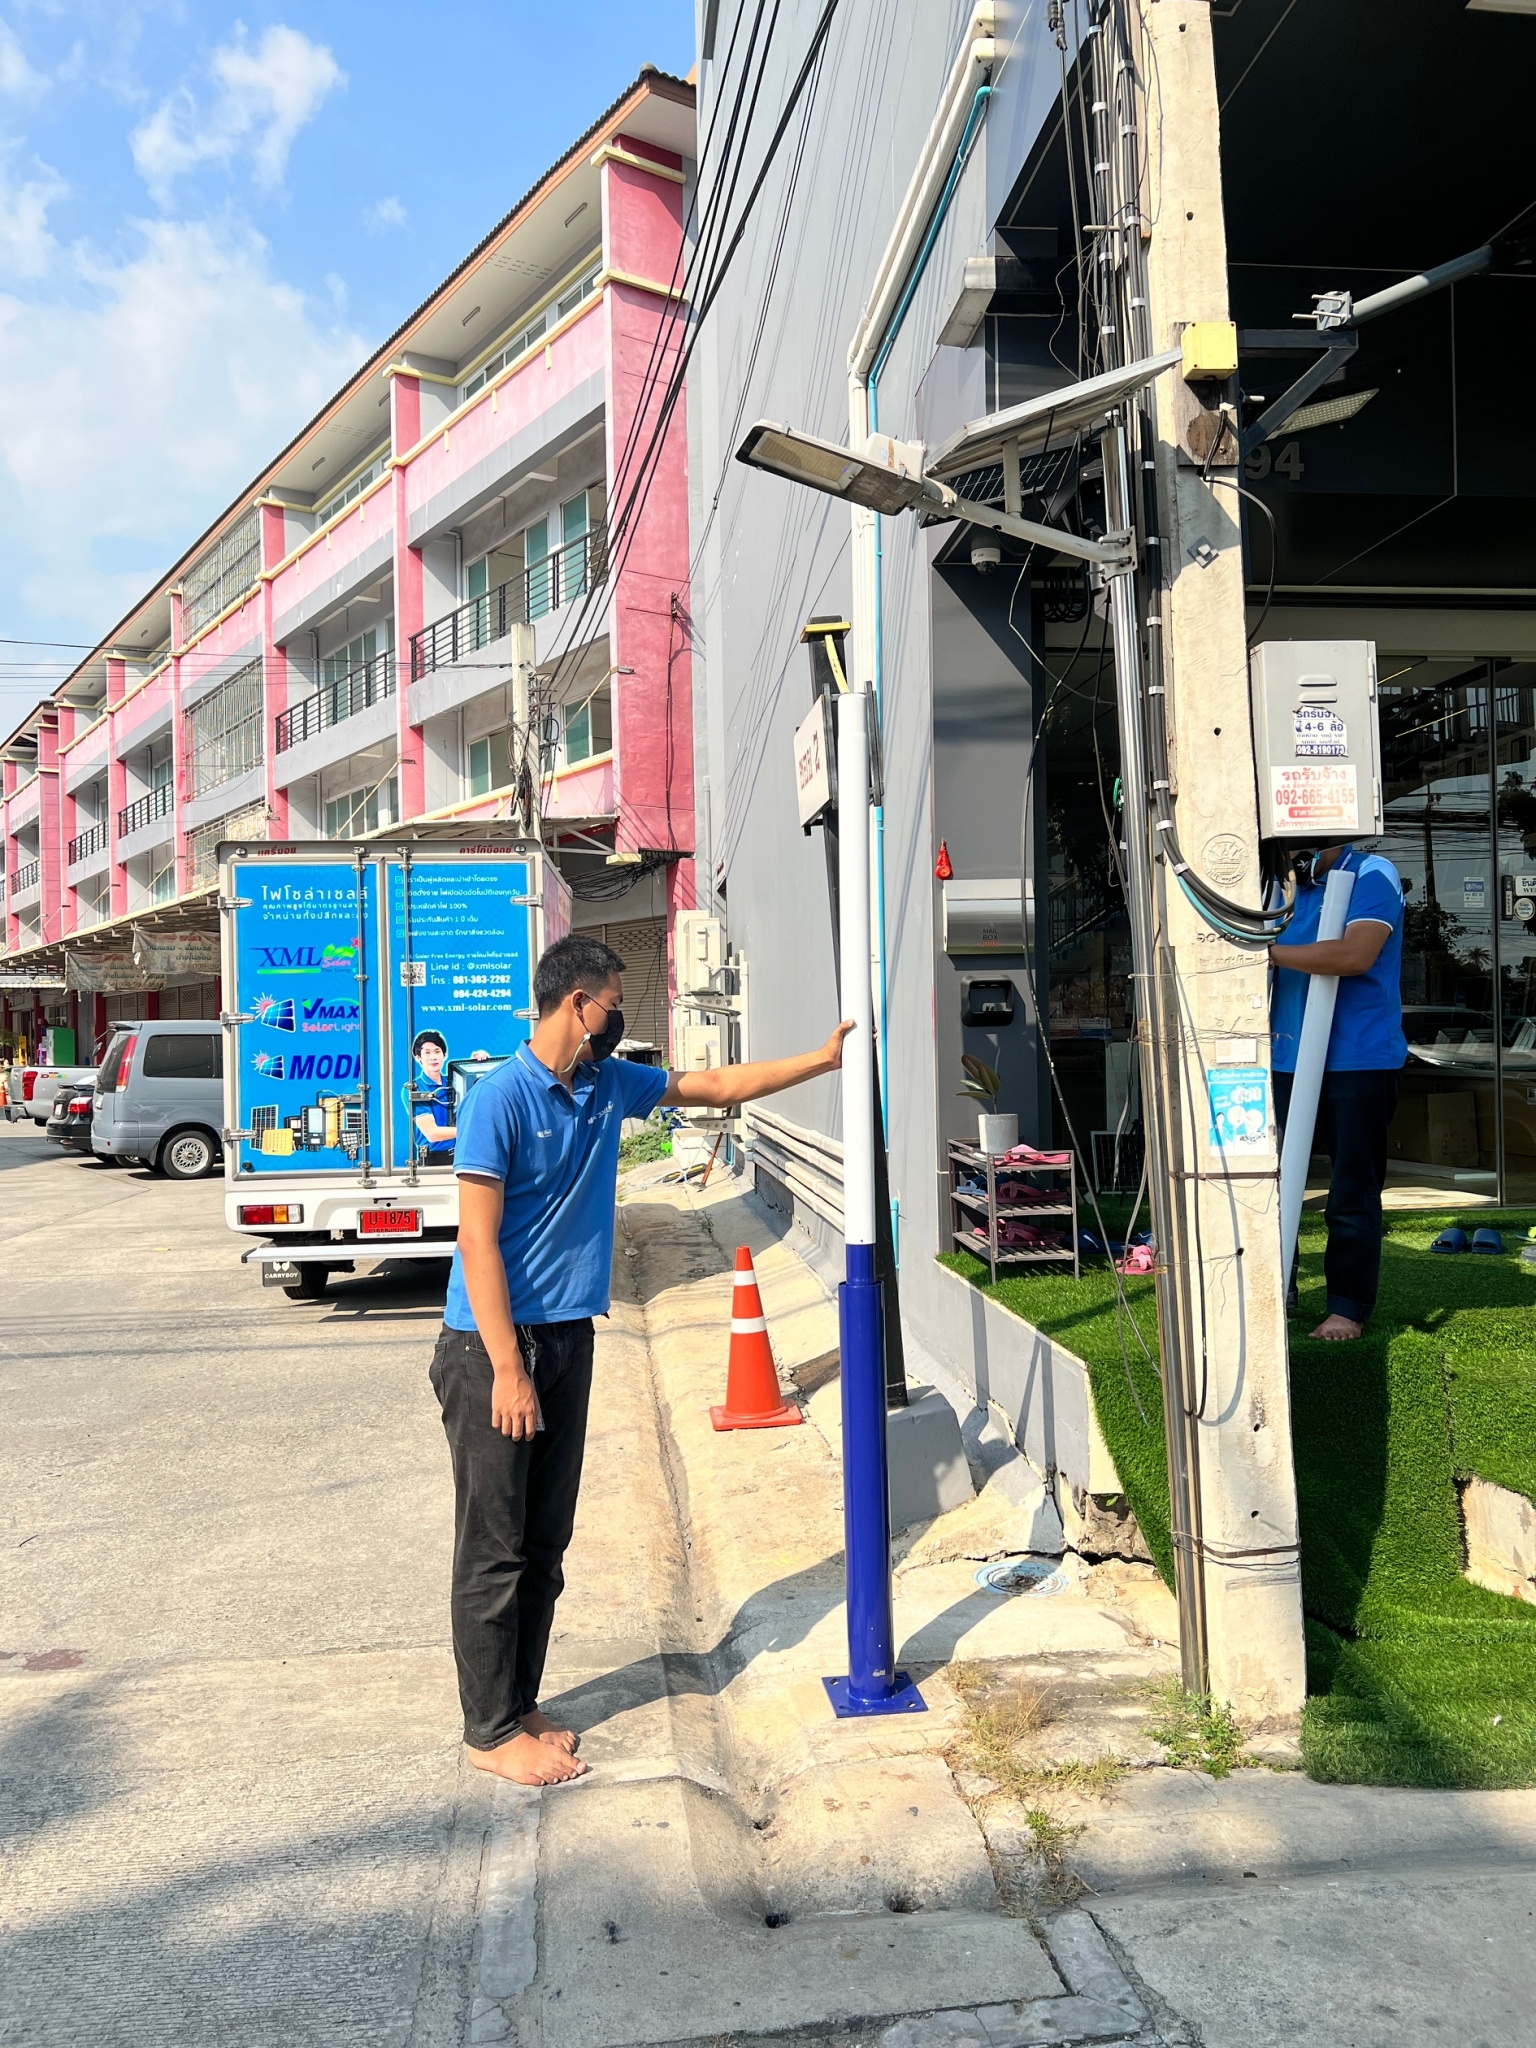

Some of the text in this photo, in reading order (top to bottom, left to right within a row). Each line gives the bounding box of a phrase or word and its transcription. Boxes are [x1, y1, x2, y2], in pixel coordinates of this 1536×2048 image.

[1304, 721, 1344, 732] 4-6 ล้อ
[1282, 766, 1346, 780] รถรับจ้าง
[1276, 789, 1355, 805] 092-665-4155
[249, 946, 322, 967] XML
[430, 962, 450, 971] Line
[451, 962, 460, 970] id
[467, 962, 512, 970] @xmlsolar
[430, 975, 446, 985] โทร
[301, 998, 360, 1019] VMAX
[421, 1003, 512, 1012] www.xml-solar.com
